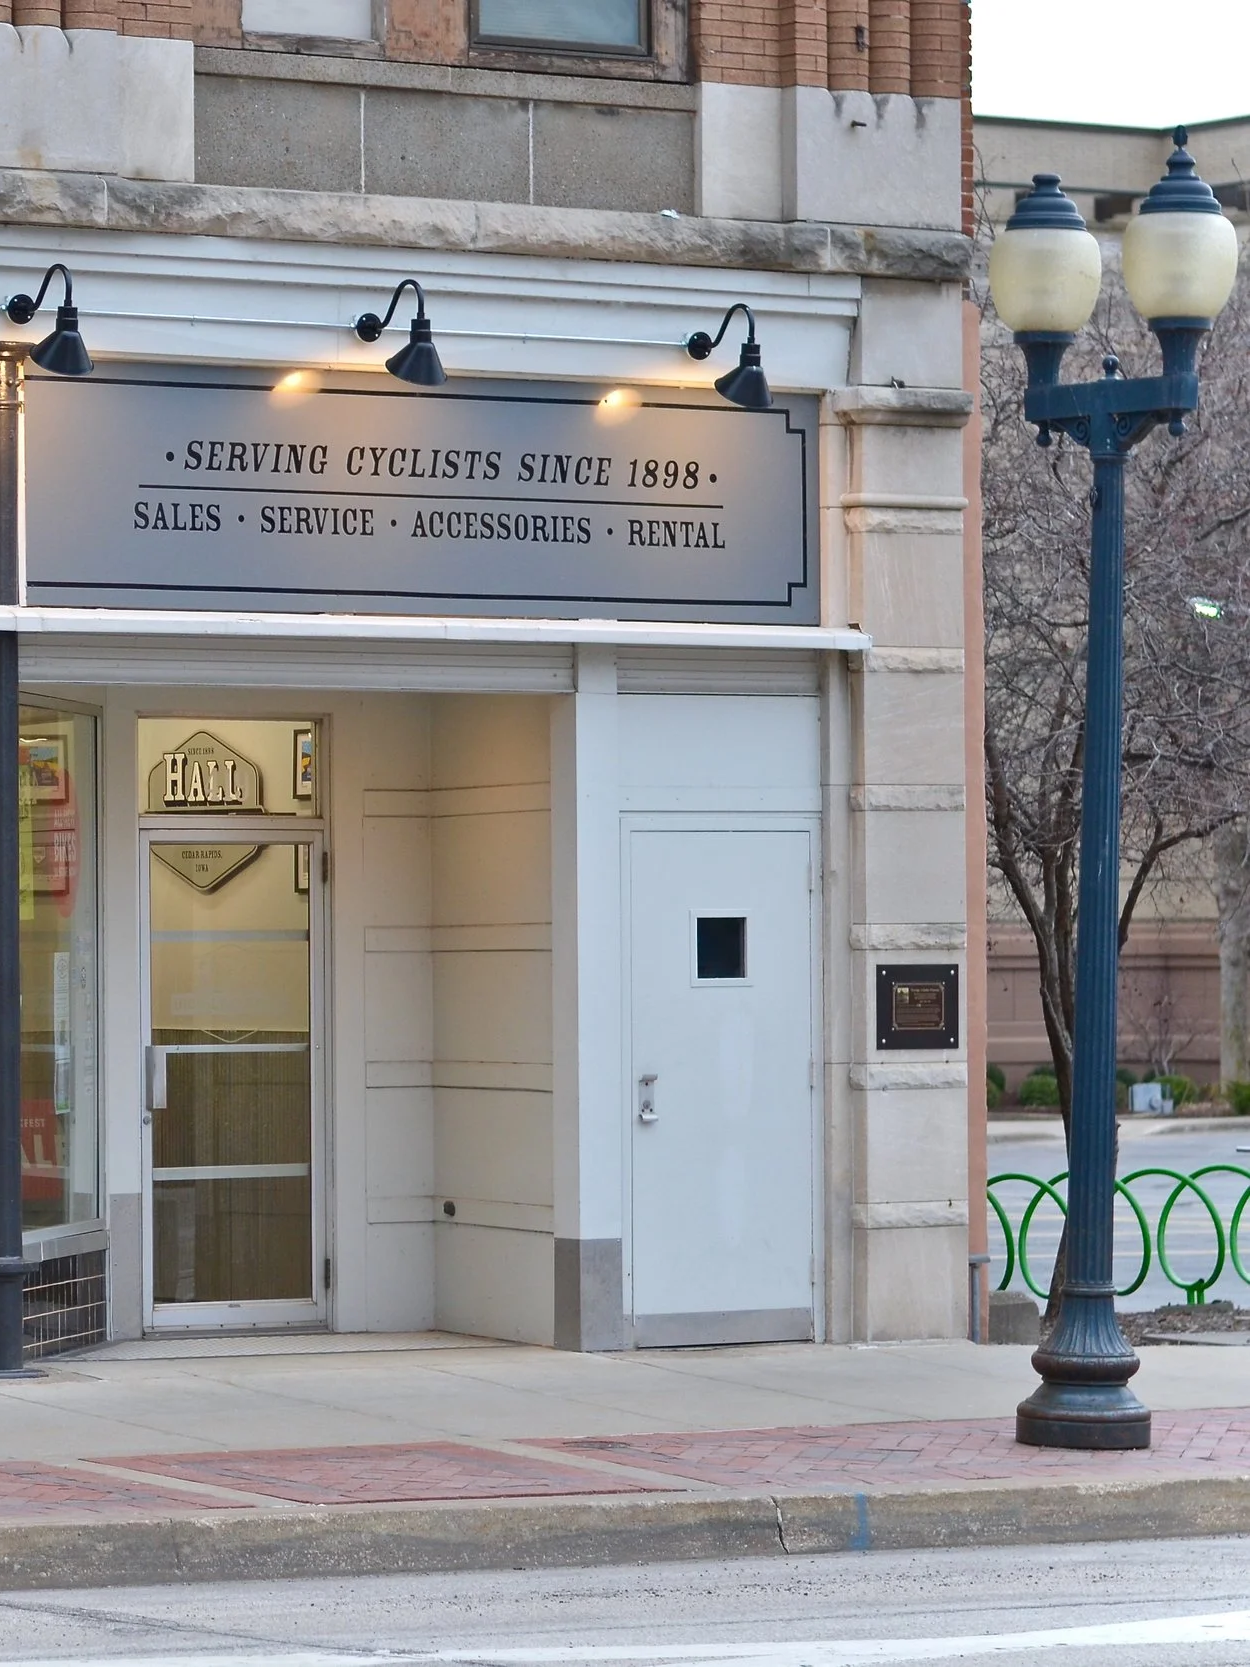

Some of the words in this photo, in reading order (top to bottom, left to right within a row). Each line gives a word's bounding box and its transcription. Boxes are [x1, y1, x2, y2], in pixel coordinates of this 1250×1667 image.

[183, 440, 329, 476] SERVING
[345, 446, 501, 481] CYCLISTS
[517, 452, 612, 487] SINCE
[626, 458, 700, 490] 1898
[133, 502, 222, 532] SALES
[260, 505, 375, 536] SERVICE
[410, 509, 592, 544] ACCESSORIES
[627, 518, 726, 549] RENTAL
[163, 752, 243, 807] HALL
[181, 850, 200, 859] CEDAR
